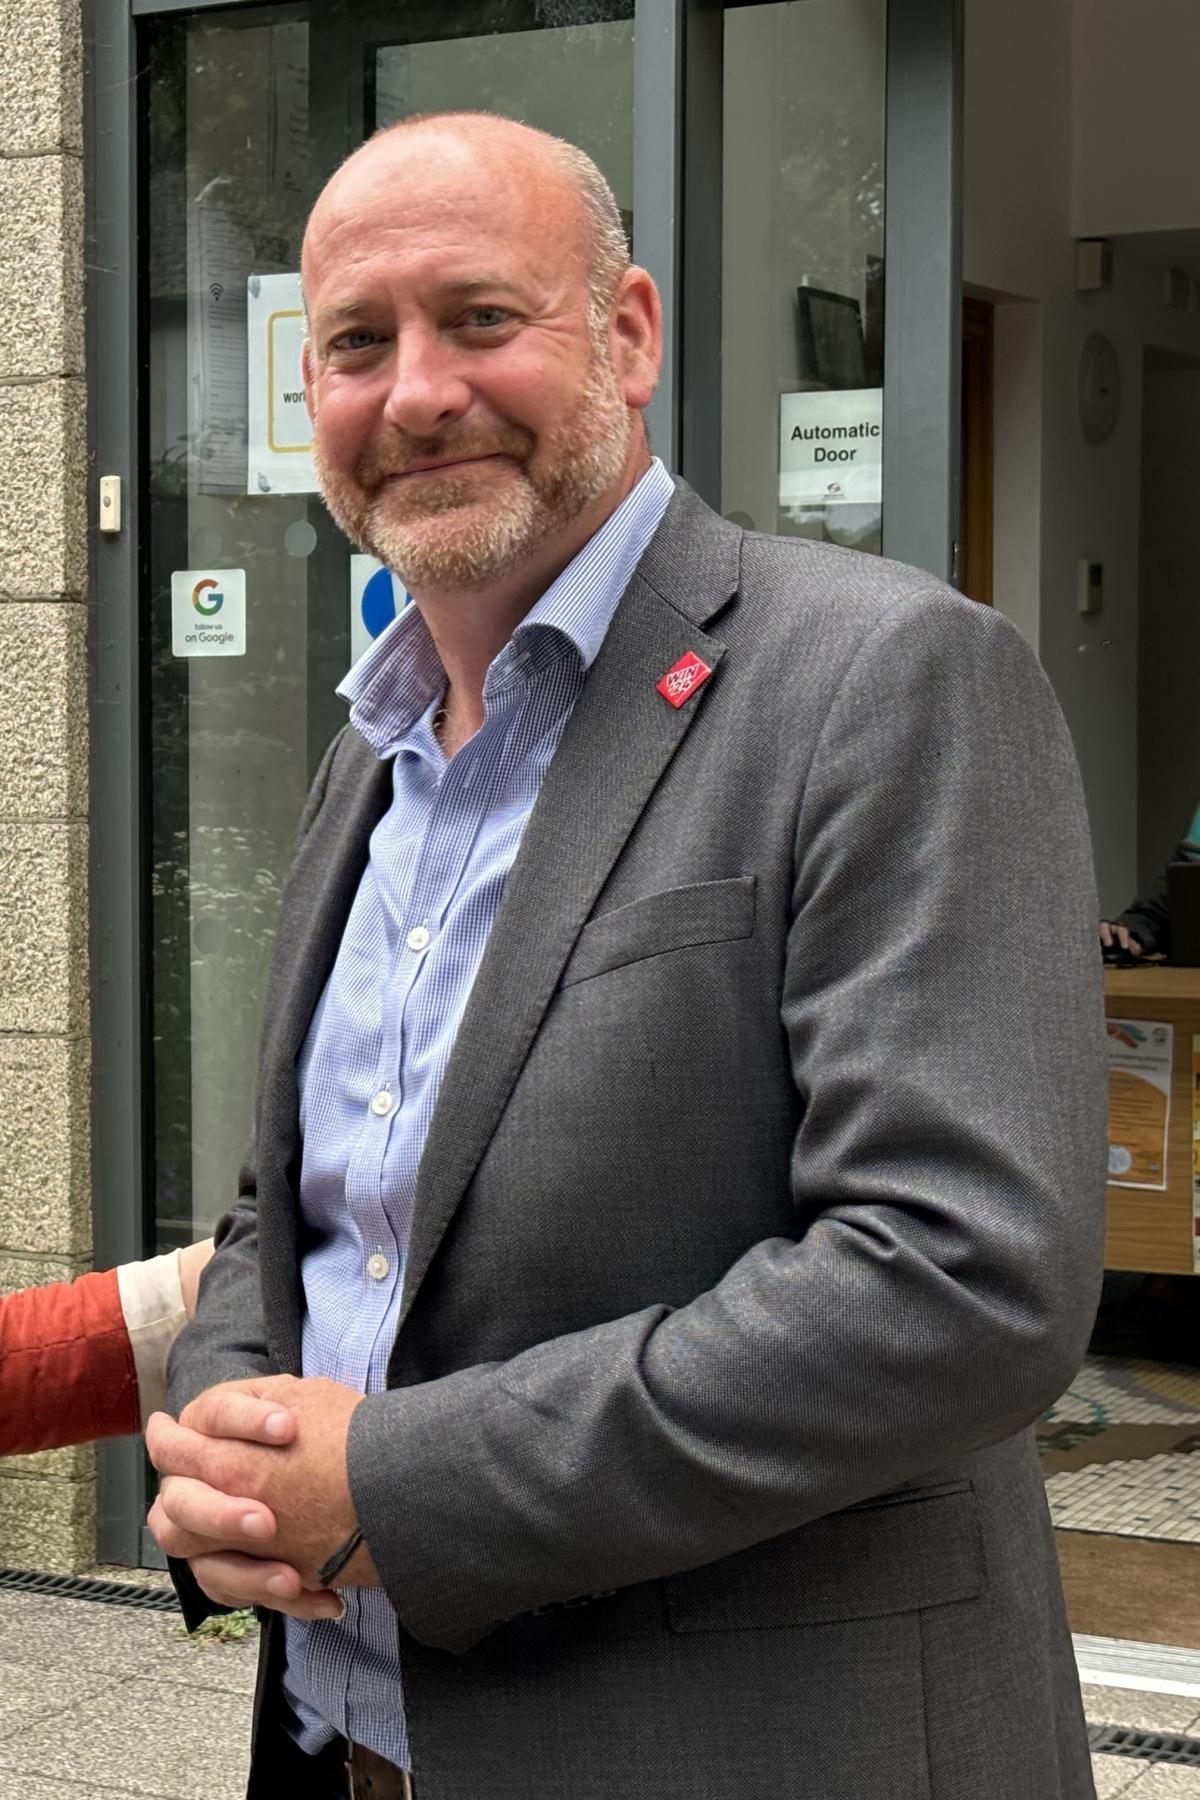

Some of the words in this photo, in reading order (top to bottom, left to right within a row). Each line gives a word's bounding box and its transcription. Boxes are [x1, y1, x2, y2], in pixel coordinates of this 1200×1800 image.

[790, 422, 880, 441] Automatic
[814, 447, 857, 463] Door
[185, 635, 197, 643] on
[198, 632, 234, 644] Google
